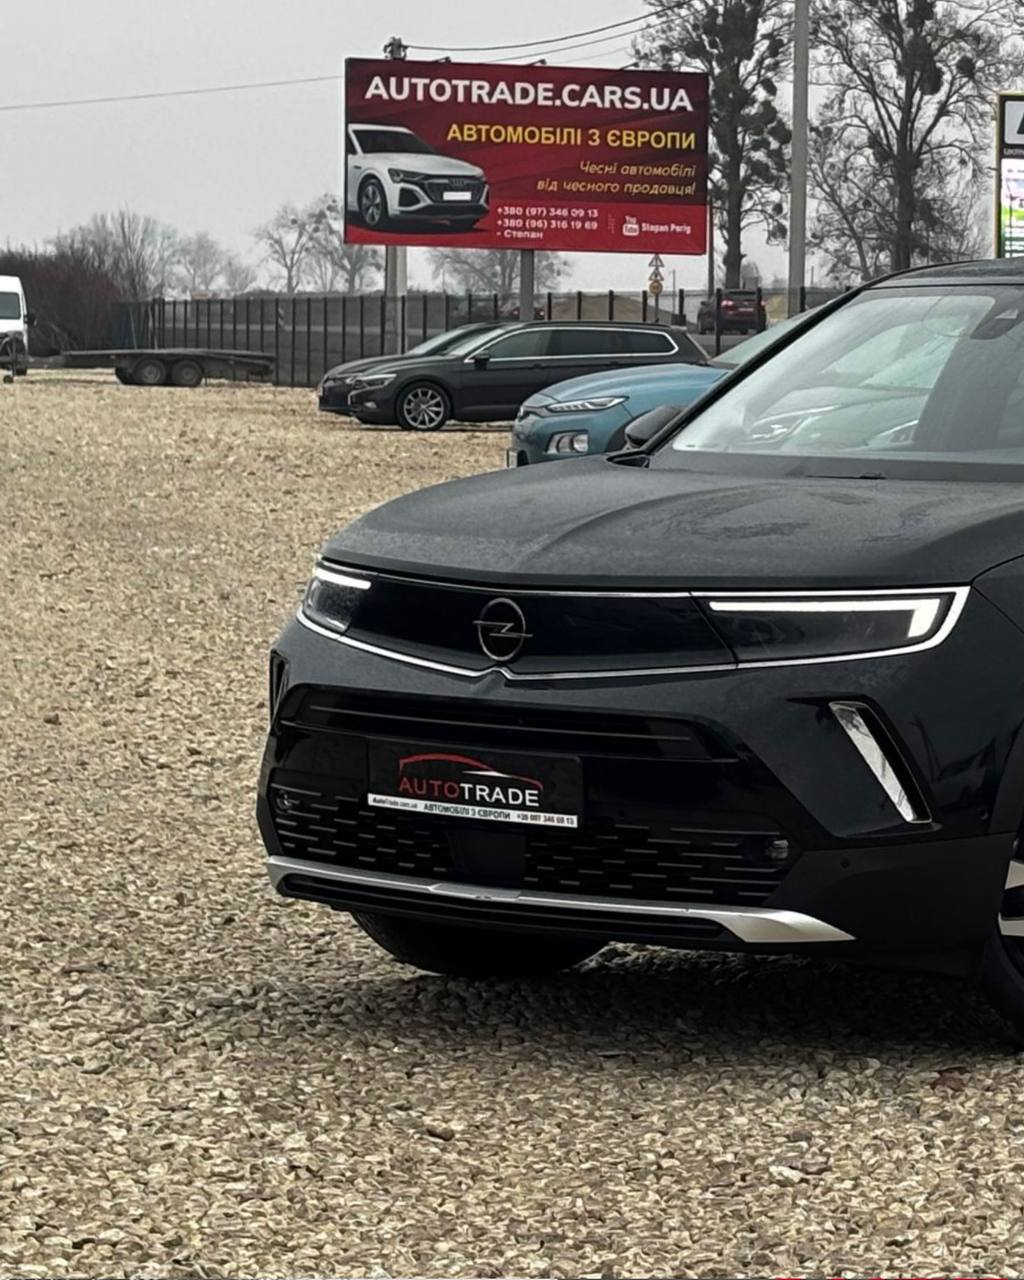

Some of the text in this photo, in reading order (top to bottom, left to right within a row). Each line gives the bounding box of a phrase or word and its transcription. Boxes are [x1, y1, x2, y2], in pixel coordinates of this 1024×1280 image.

[364, 76, 694, 112] AUTOTRADE.CARS.UA
[447, 123, 696, 150] АВТОМОБІЛІ З ЄВРОПИ
[580, 160, 697, 178] Чесні автомобілі
[537, 178, 697, 196] від чесного продавця!
[497, 206, 523, 216] +380
[587, 209, 599, 218] 13
[497, 218, 523, 228] +380
